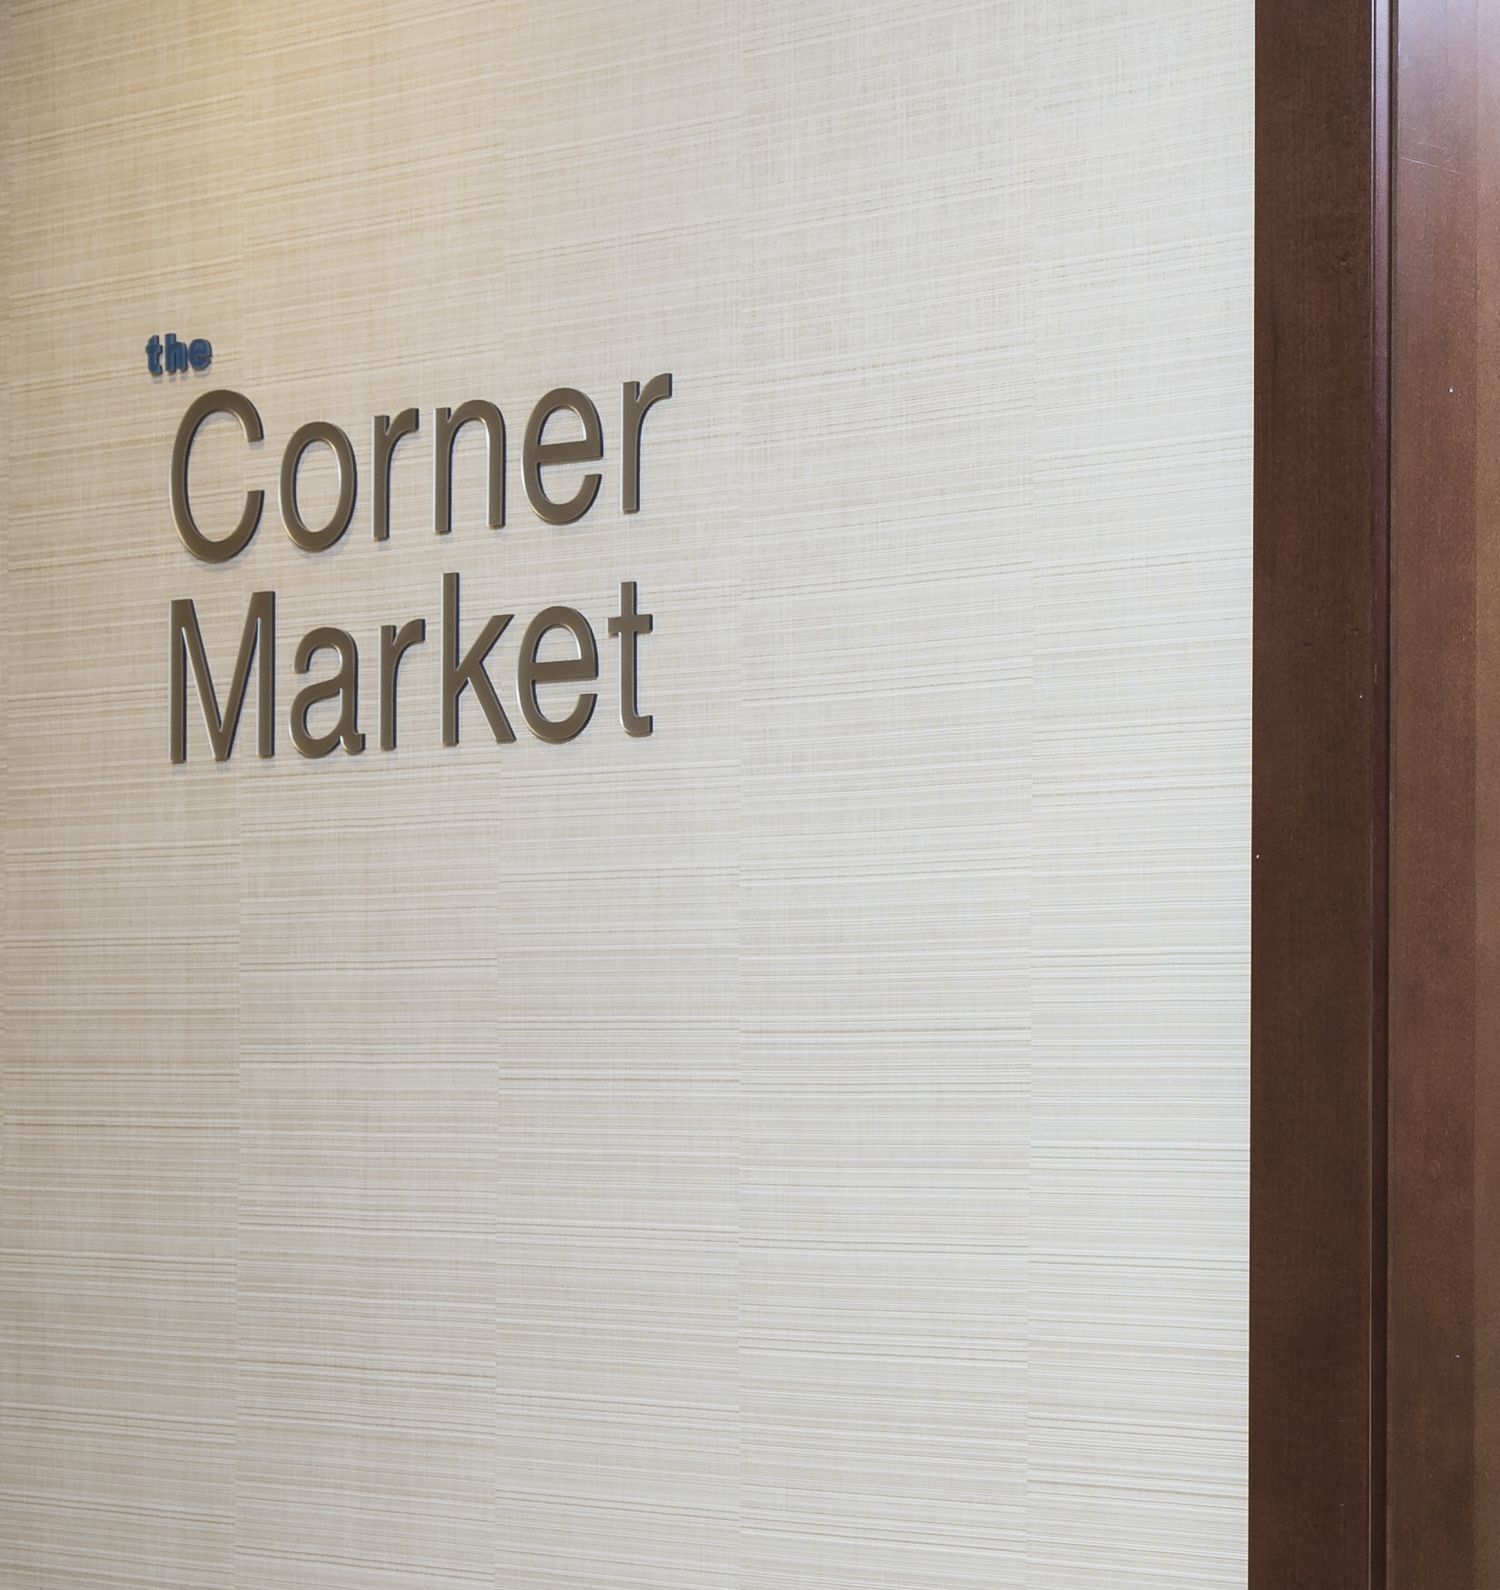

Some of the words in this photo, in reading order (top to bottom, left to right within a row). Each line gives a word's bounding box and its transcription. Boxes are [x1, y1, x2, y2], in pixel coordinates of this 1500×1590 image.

[145, 333, 212, 376] the
[170, 373, 672, 563] Corner
[169, 572, 653, 764] Market
